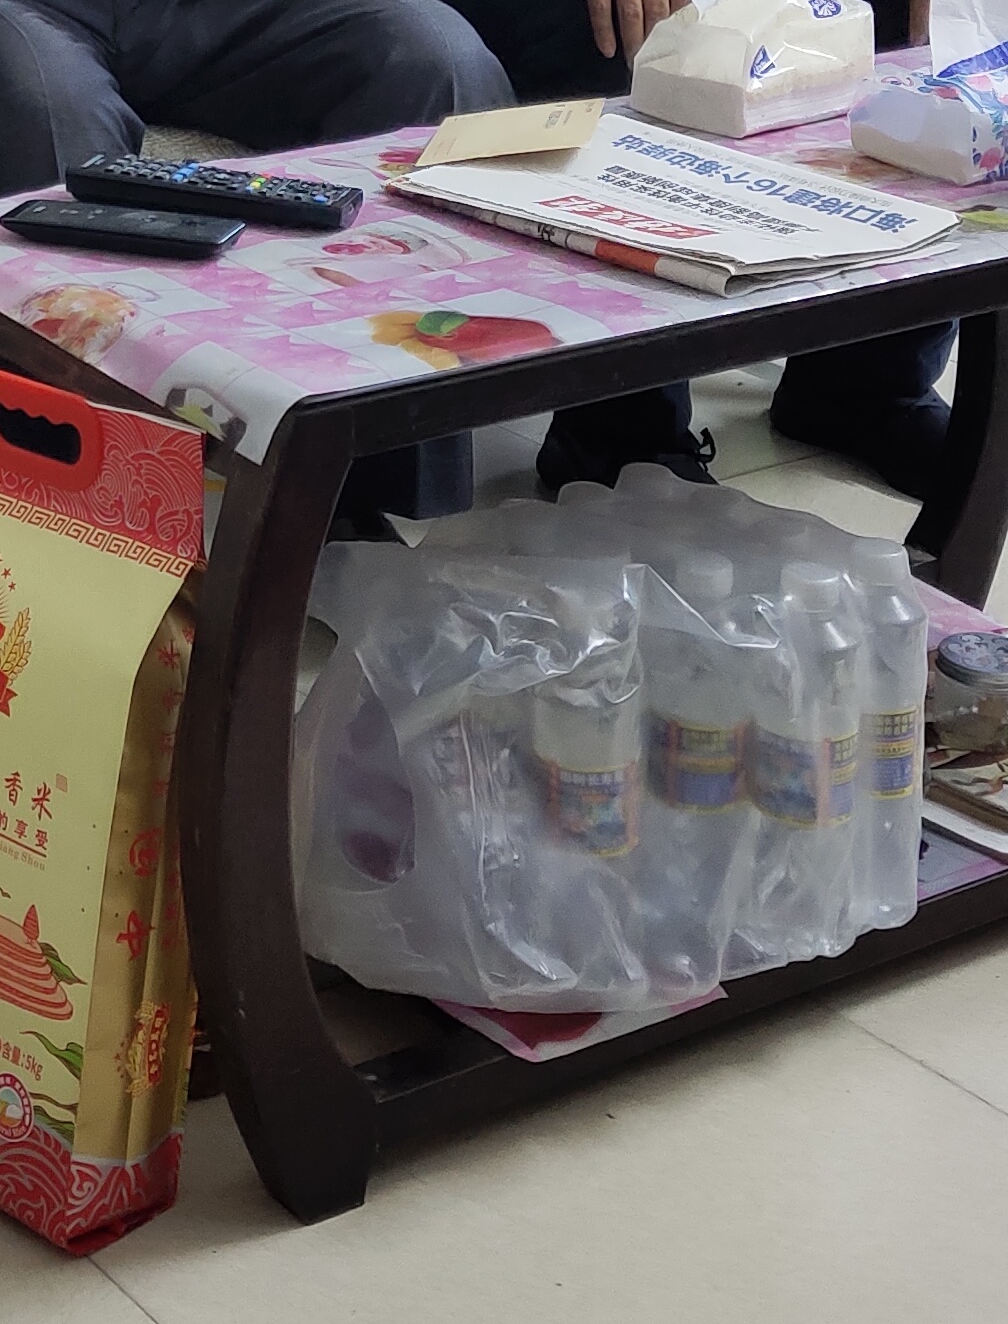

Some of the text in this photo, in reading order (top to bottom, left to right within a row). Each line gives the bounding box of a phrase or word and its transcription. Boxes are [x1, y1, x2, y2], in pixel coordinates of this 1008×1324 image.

[611, 133, 919, 235] 海口将建16个海边驿站
[21, 852, 46, 872] Shou
